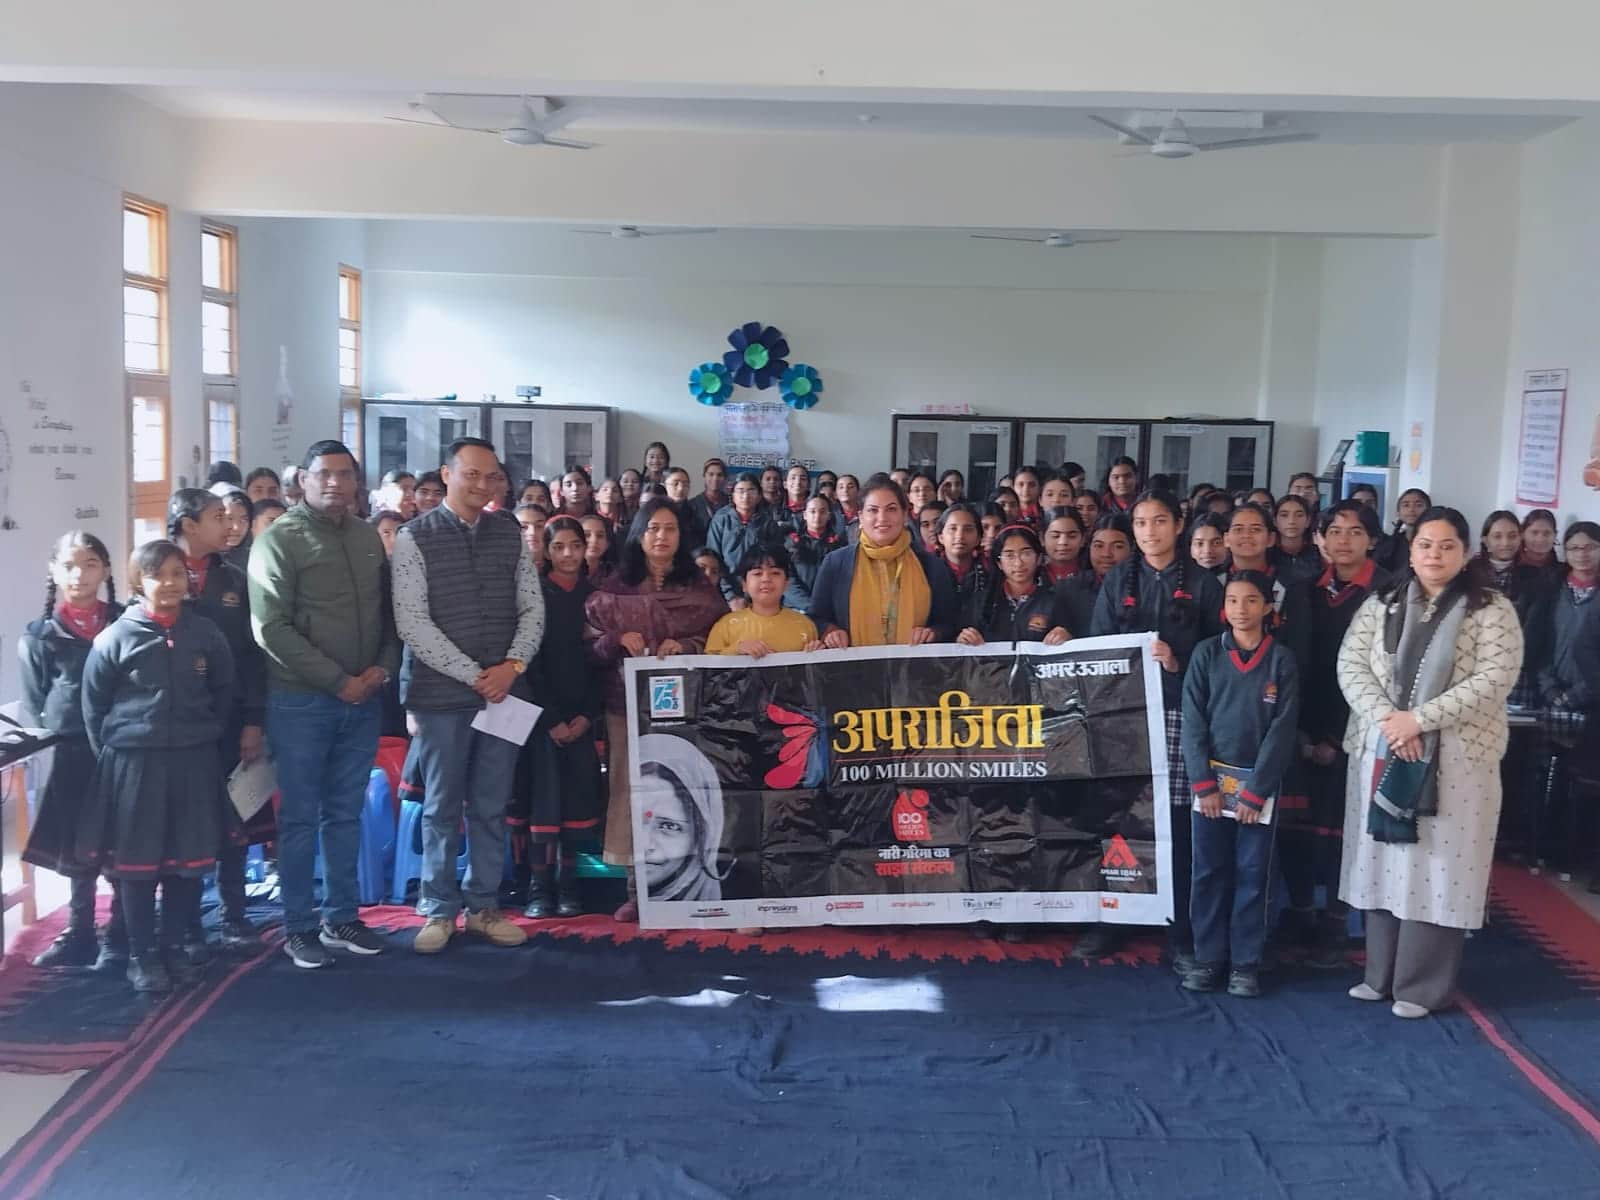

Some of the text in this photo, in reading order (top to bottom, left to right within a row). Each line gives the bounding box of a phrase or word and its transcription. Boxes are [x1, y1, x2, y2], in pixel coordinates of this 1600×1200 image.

[1035, 659, 1131, 679] अमर उजाला
[832, 690, 1046, 753] अपराजिता
[840, 761, 1048, 782] 100 MILLION SMILES
[897, 812, 922, 825] 100
[878, 844, 901, 860] नारी
